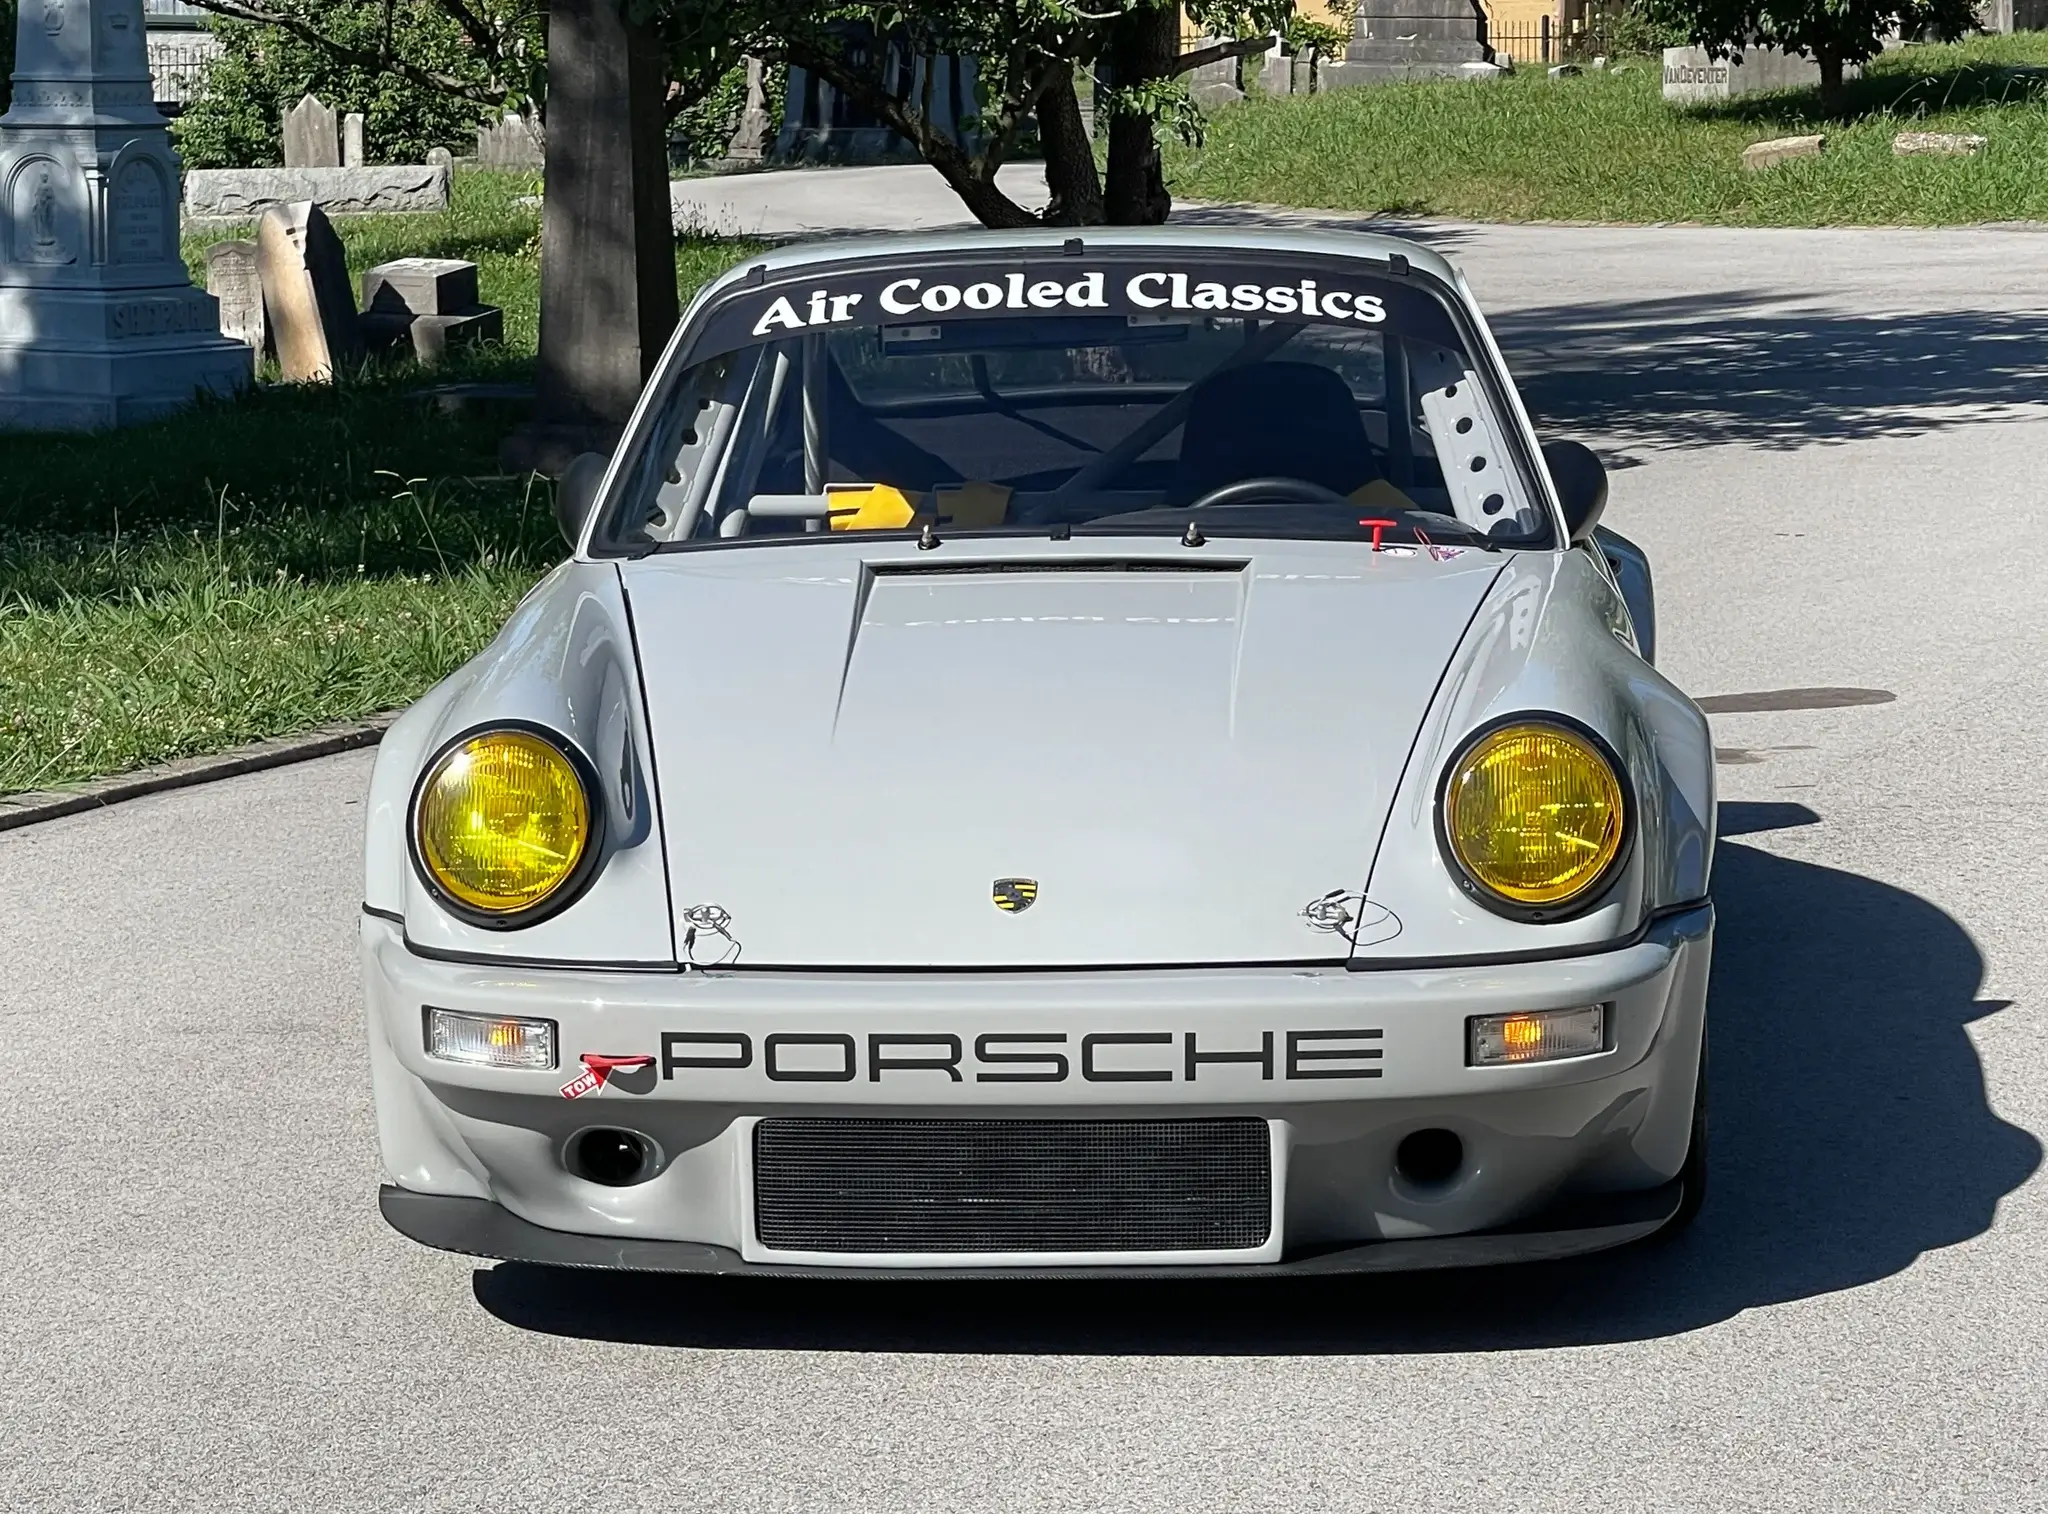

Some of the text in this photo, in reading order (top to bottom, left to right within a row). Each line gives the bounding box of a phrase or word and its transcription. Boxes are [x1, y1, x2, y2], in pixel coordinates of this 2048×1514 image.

[753, 273, 1386, 335] Air Cooled Classics
[661, 1029, 1384, 1082] PORSCHE
[564, 1072, 598, 1098] TOW
